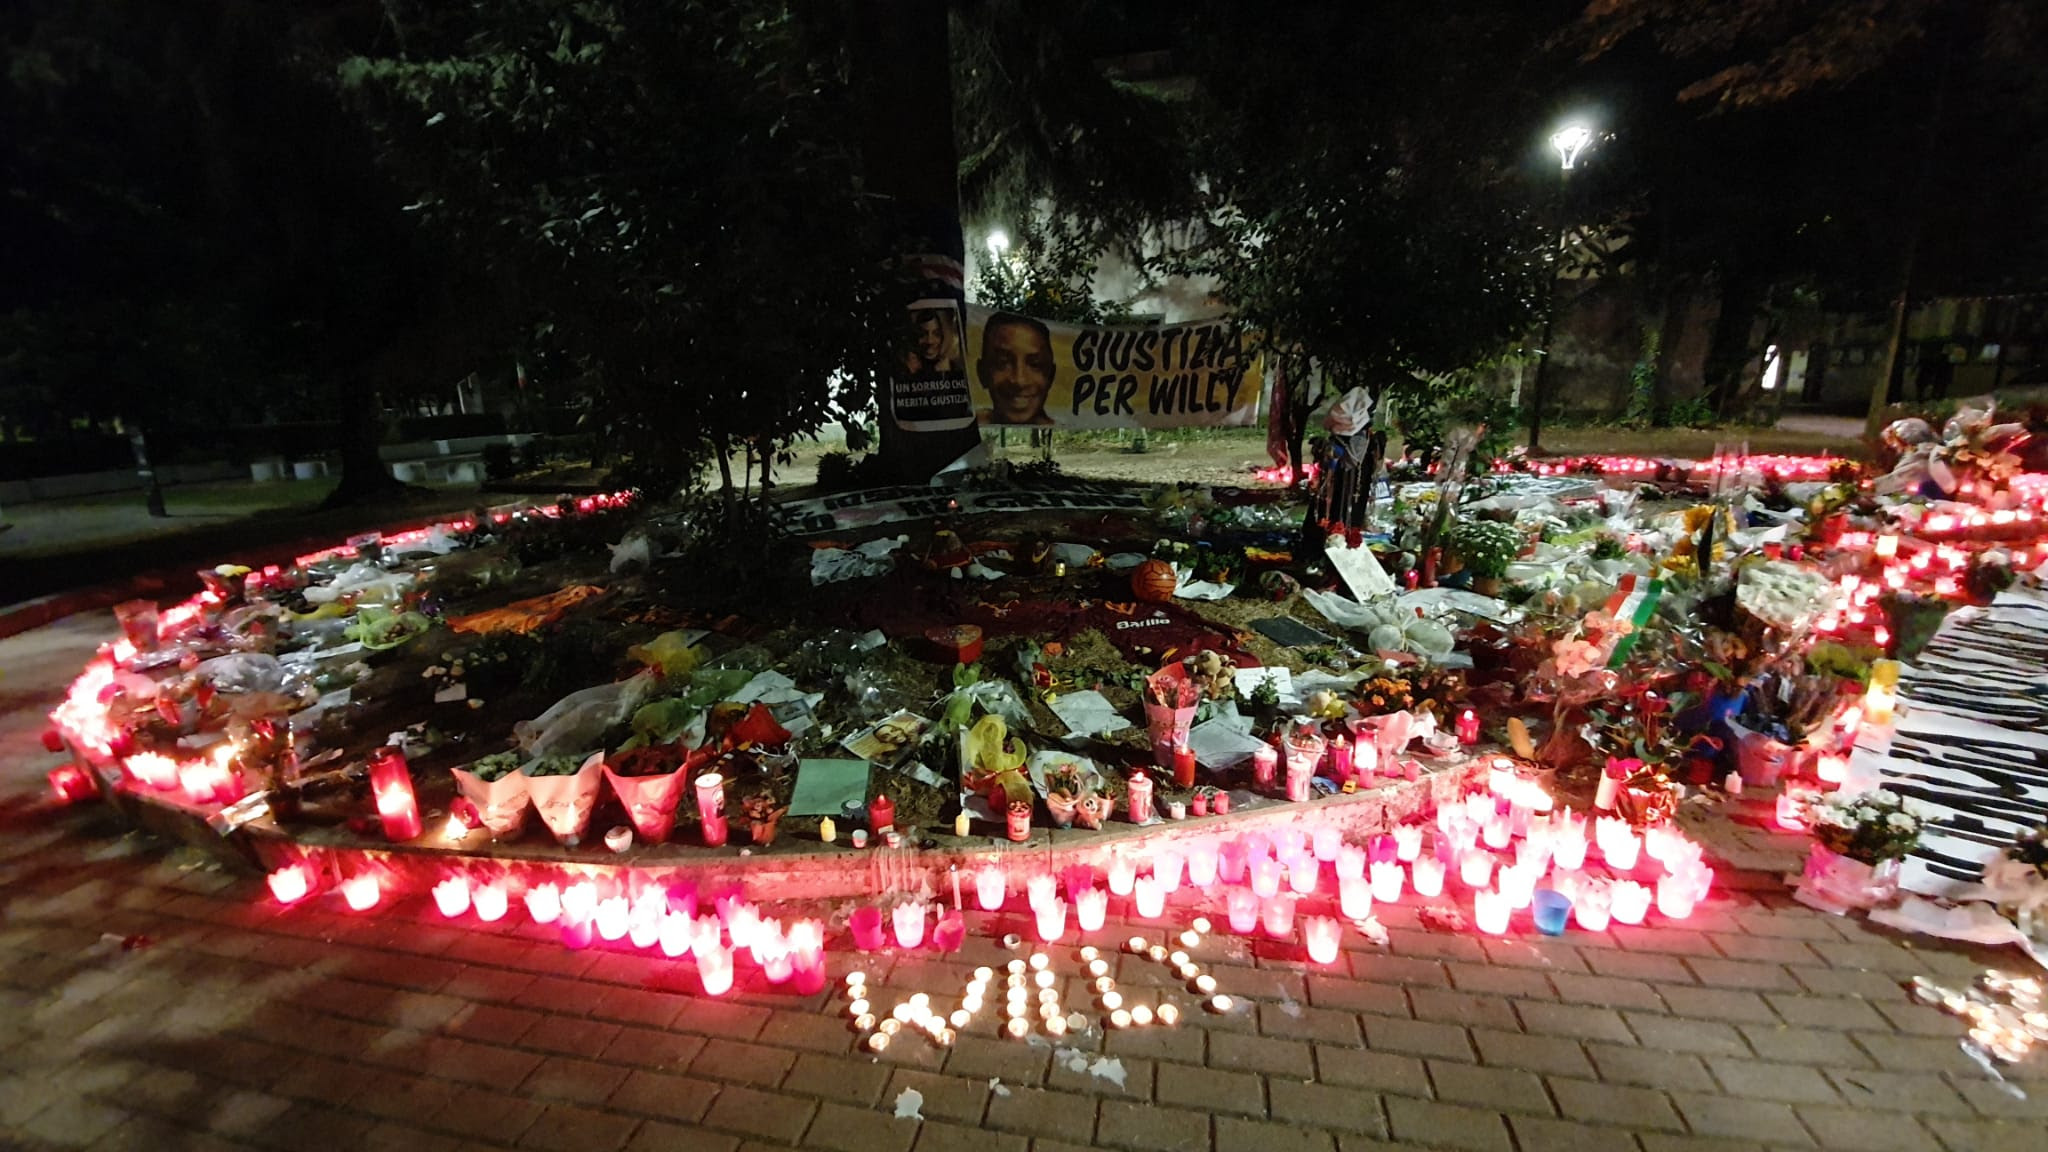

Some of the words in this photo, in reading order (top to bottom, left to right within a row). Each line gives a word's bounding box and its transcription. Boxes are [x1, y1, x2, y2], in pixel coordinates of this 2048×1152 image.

[1072, 324, 1243, 372] GIUSTIZIA
[895, 383, 910, 393] UN
[911, 380, 950, 392] SORRISO
[1072, 374, 1138, 416] PER
[1148, 367, 1244, 416] WILLY
[896, 397, 930, 408] MERITA
